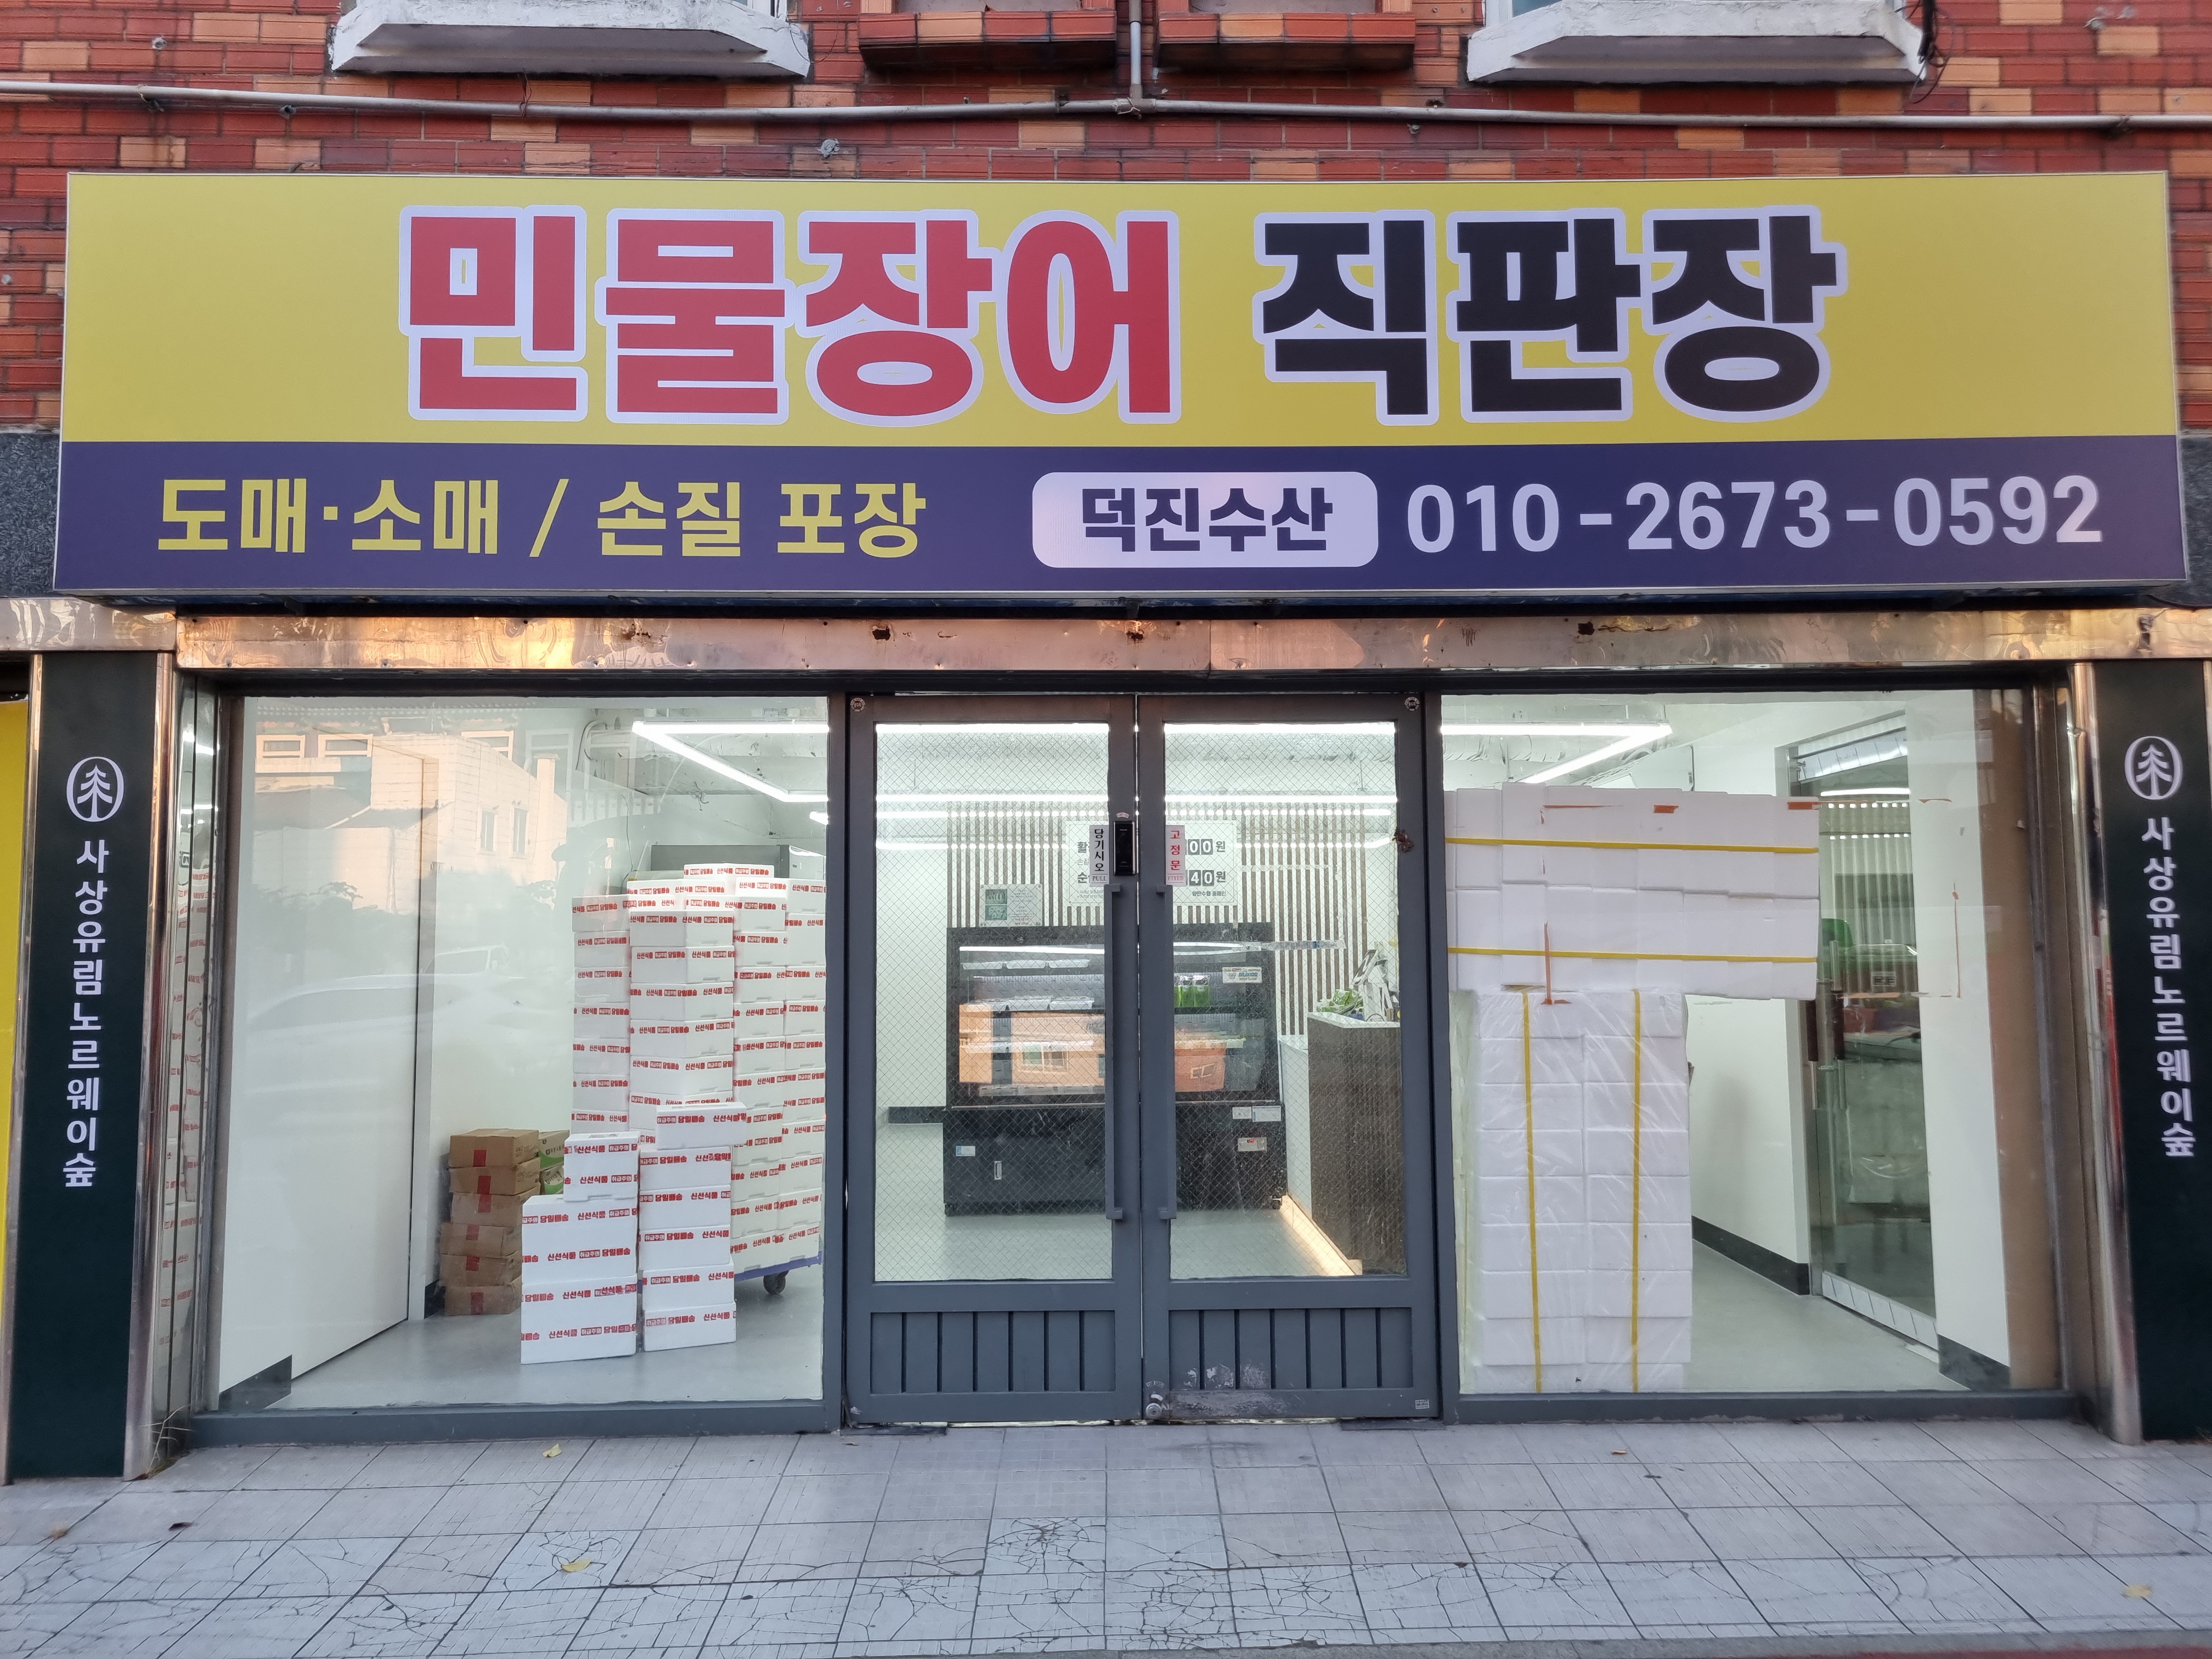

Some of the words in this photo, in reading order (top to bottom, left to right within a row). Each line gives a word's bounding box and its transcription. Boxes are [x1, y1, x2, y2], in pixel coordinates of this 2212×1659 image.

[409, 215, 1172, 417] 민물장어
[1263, 215, 1837, 416] 직판장
[597, 481, 742, 557] 손질
[776, 481, 926, 558] 포장
[1081, 487, 1333, 552] 덕진수산
[1094, 828, 1105, 872] 당기시오
[1170, 830, 1181, 871] 고정문
[580, 1175, 608, 1184] 신선식품
[691, 1192, 718, 1200] 신선식품
[577, 1210, 606, 1221] 신선식품
[702, 1229, 729, 1239] 신선식품
[548, 1251, 577, 1262] 신선식품
[708, 1271, 734, 1281] 신선식품
[562, 1289, 591, 1300] 신선식품
[703, 1311, 731, 1322] 신선식품
[549, 1329, 578, 1339] 신선식품
